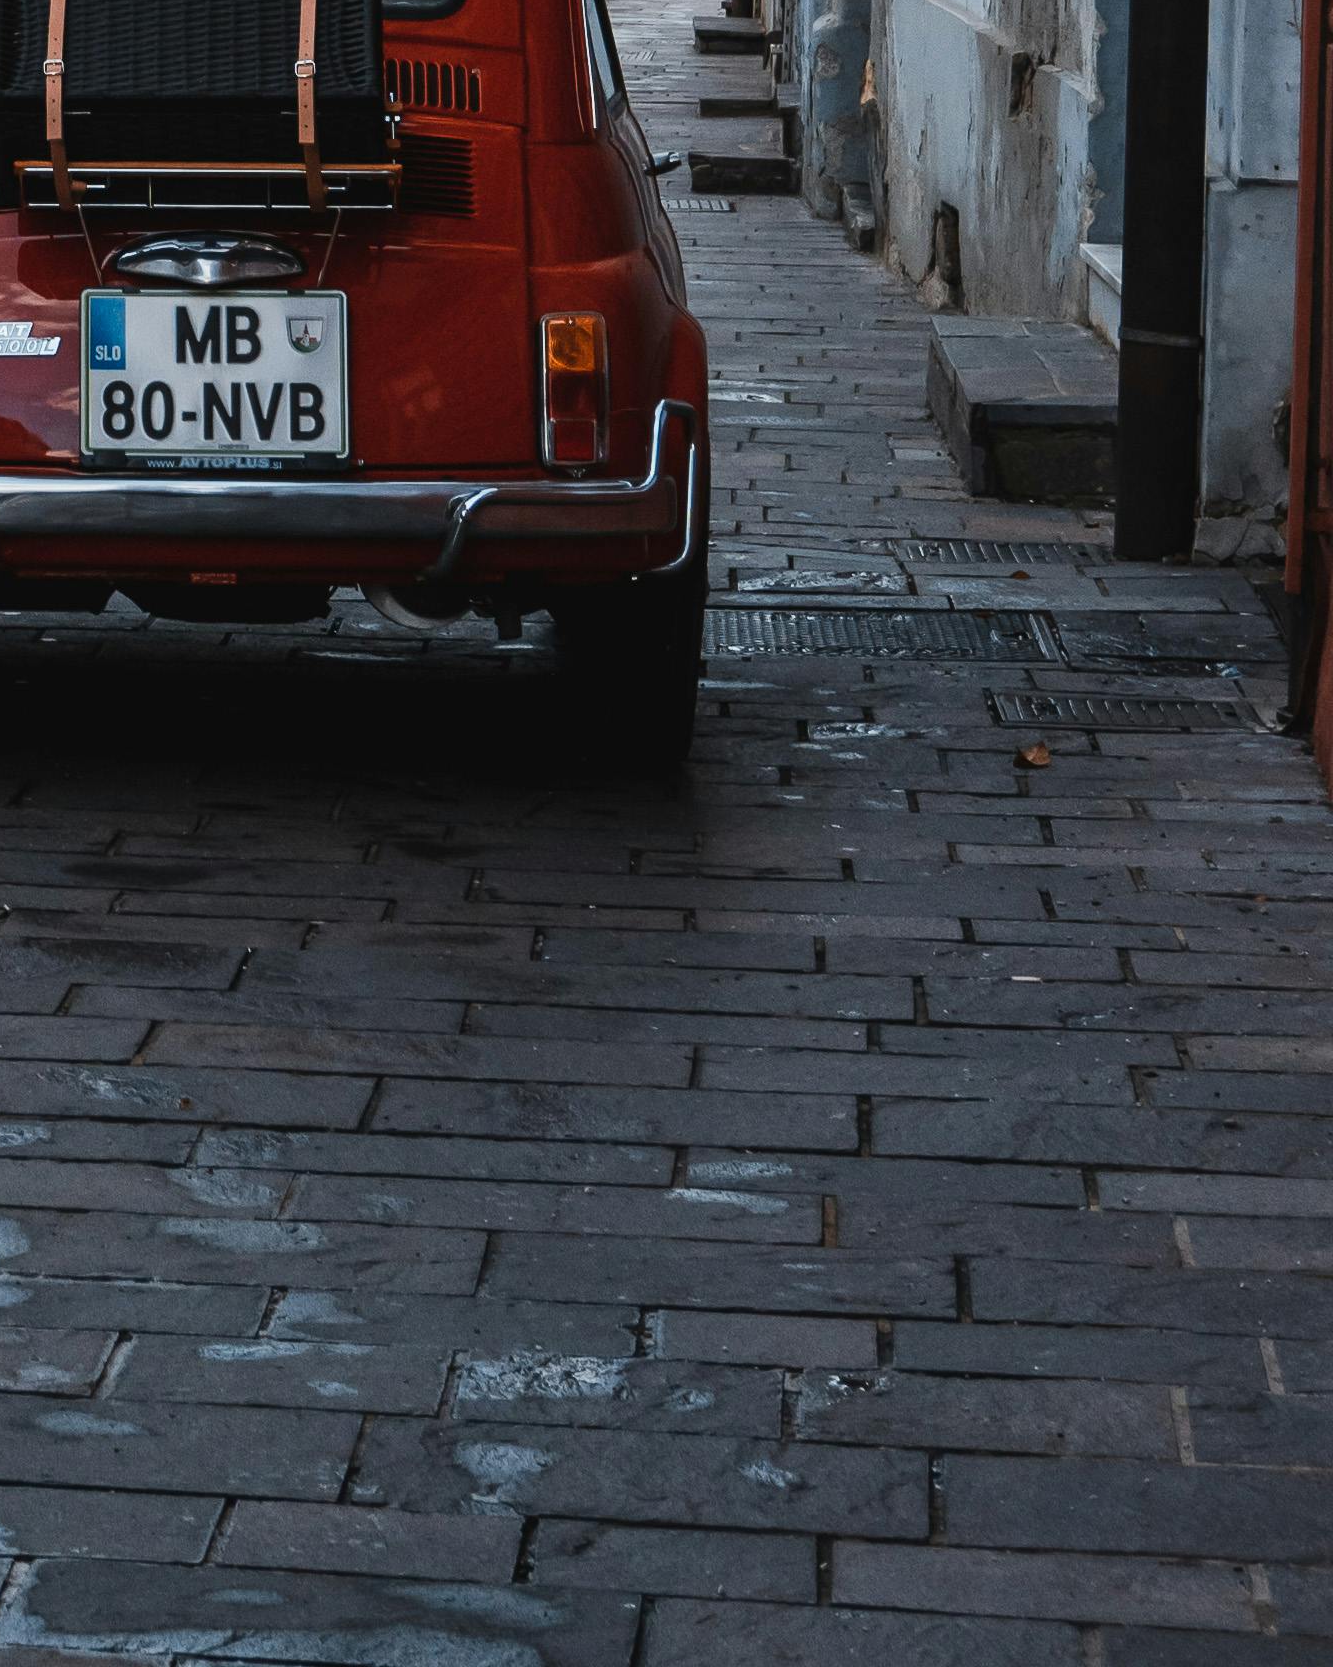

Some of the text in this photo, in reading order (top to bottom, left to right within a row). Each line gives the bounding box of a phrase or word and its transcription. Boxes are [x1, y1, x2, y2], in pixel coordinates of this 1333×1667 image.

[95, 345, 121, 361] SLO
[175, 305, 262, 364] MB
[102, 380, 325, 441] 80-NVB
